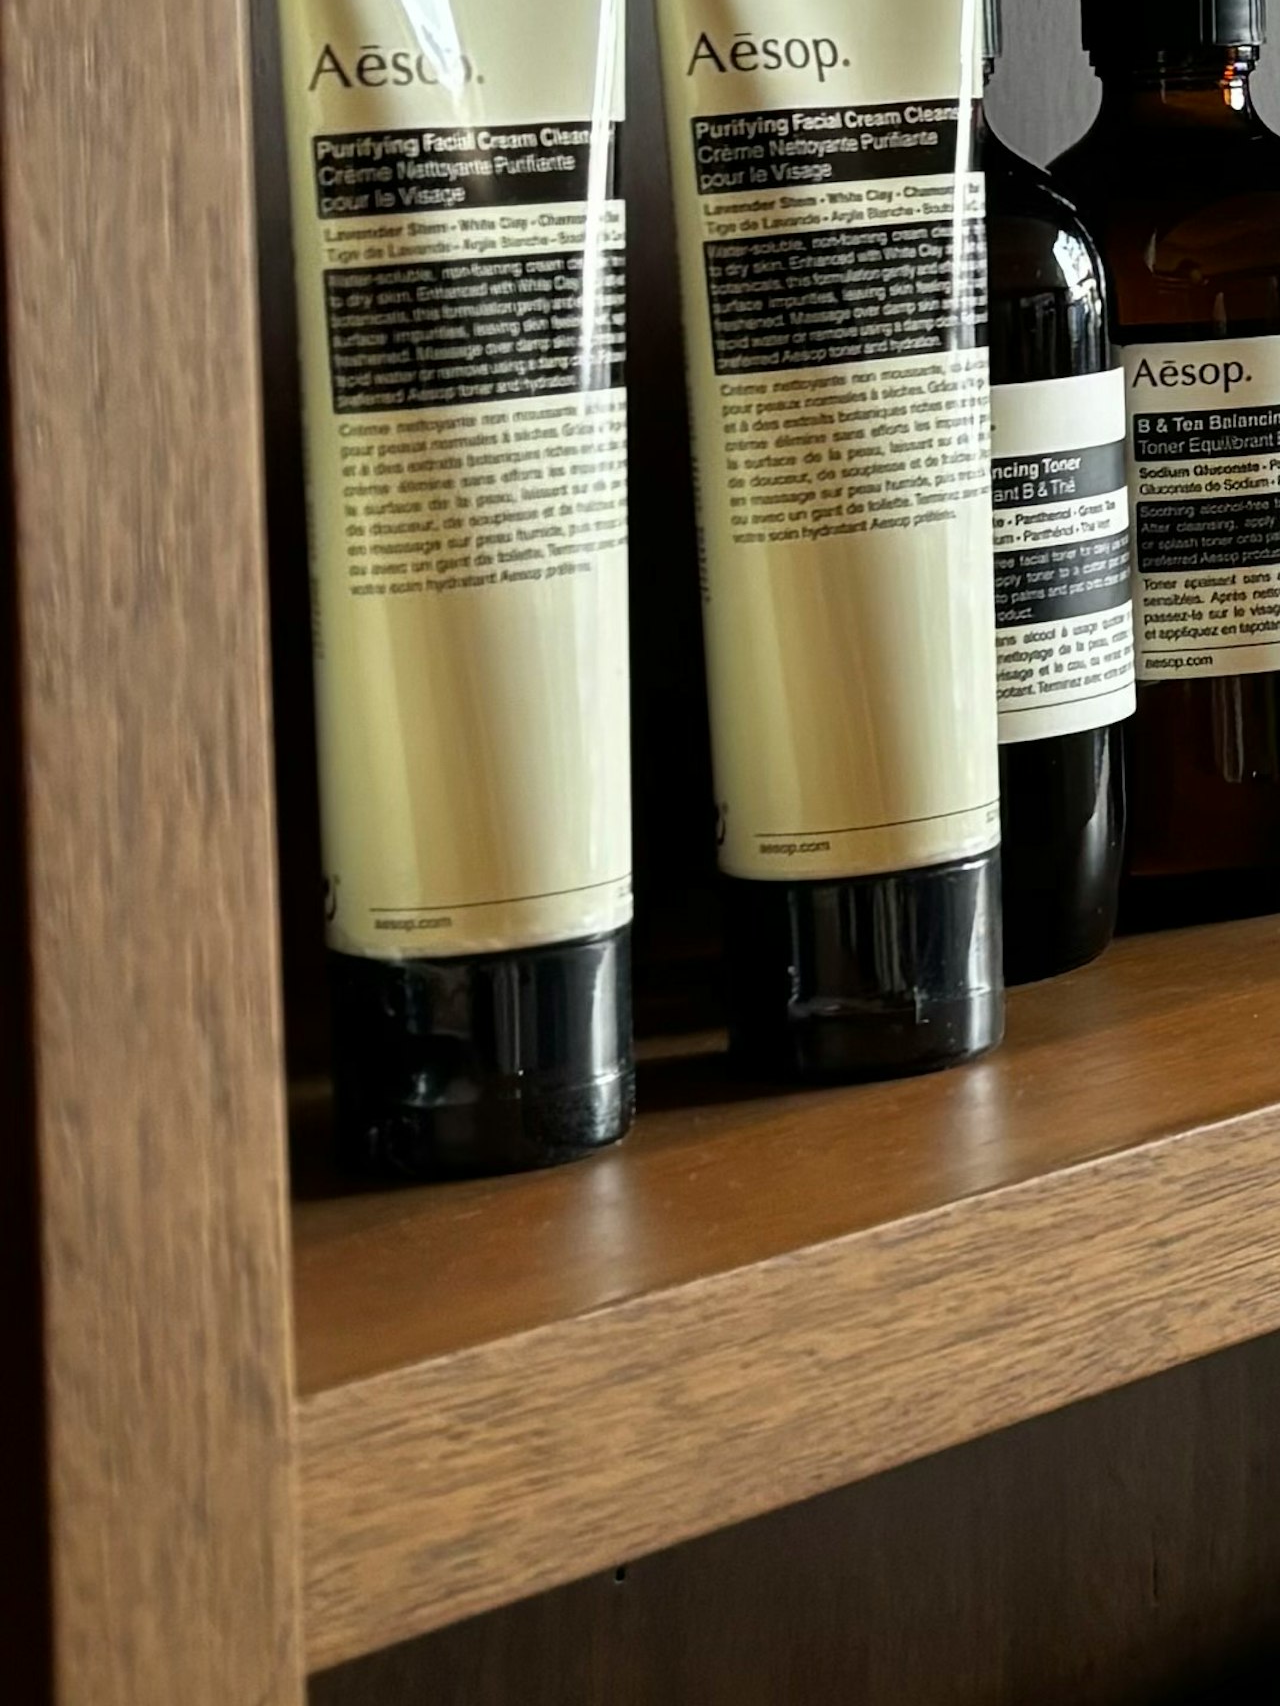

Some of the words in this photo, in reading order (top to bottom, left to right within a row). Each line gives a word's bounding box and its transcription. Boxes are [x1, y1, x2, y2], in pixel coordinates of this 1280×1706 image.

[686, 30, 851, 83] Aēsop.
[695, 118, 789, 141] Purifying
[792, 112, 841, 132] Facial
[844, 108, 902, 130] Cream
[316, 136, 419, 161] Purifying
[697, 141, 765, 164] Crème
[700, 168, 745, 190] pour
[749, 165, 769, 184] le
[772, 160, 833, 183] Visage
[1132, 358, 1253, 394] Aēsop.
[1137, 418, 1151, 434] B
[1156, 417, 1168, 433] &
[1174, 414, 1205, 433] Tea
[1138, 436, 1186, 455] Toner
[1188, 429, 1275, 453] Equilibrant
